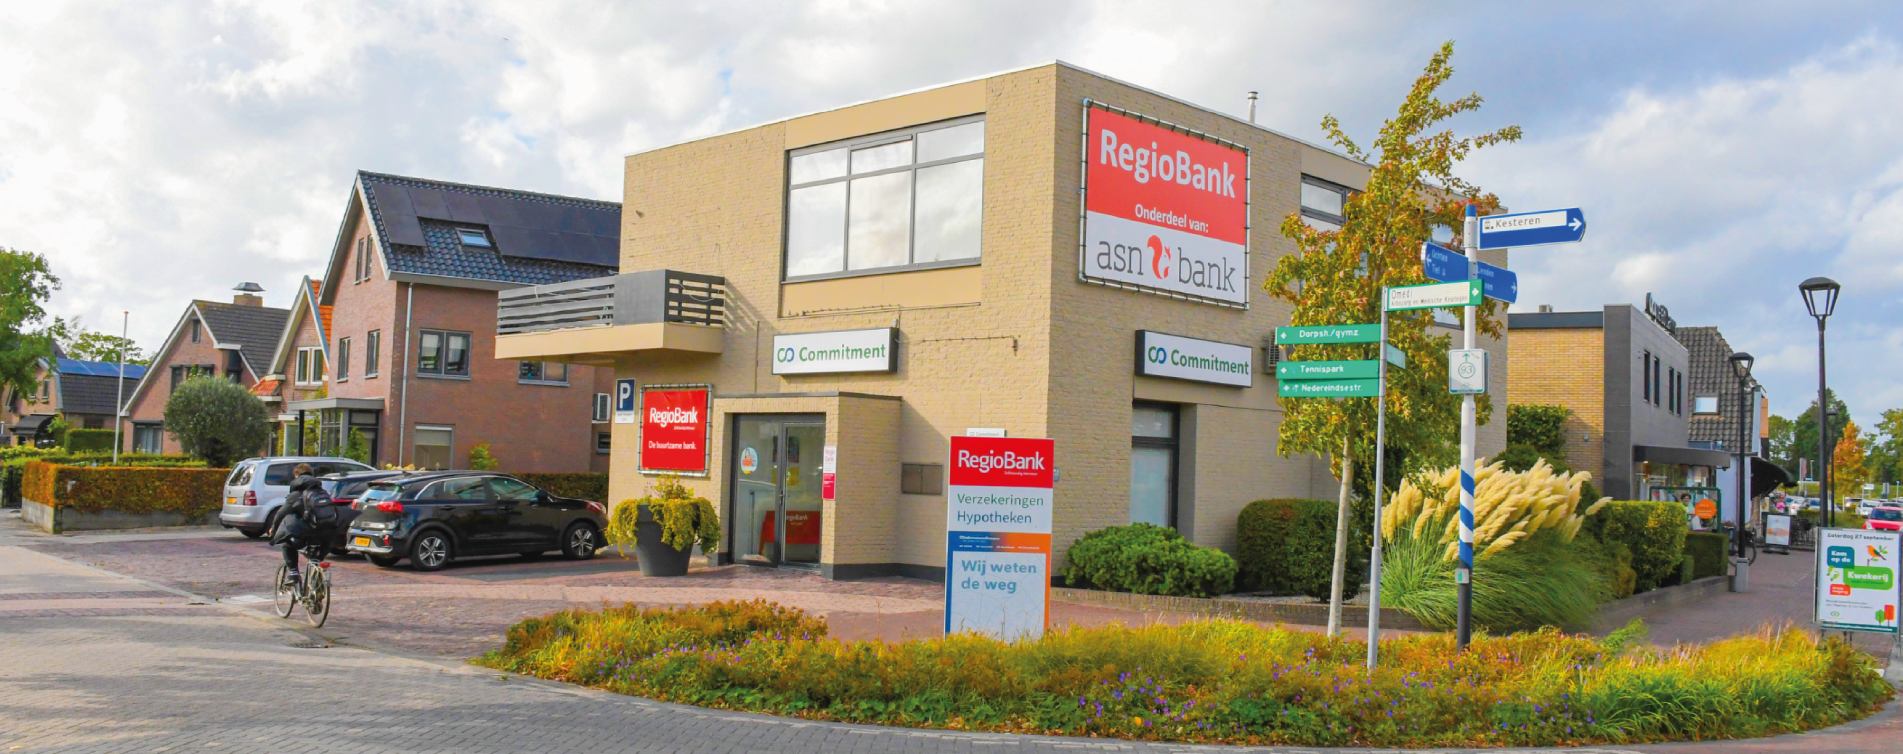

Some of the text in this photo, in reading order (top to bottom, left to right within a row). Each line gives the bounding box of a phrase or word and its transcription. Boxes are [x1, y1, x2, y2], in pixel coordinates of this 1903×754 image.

[1100, 128, 1236, 198] RegioBank
[1135, 203, 1209, 233] Onderdeel van:
[1495, 217, 1541, 228] Kesteren
[1096, 240, 1236, 293] asn bank
[799, 343, 886, 362] Commitment
[1170, 349, 1249, 375] Commitment
[1300, 365, 1344, 373] Tennispark
[619, 382, 631, 409] P
[649, 406, 698, 428] RegioBank
[958, 449, 1045, 473] RegioBank
[957, 493, 1044, 508] Verzekeringen
[957, 510, 1032, 525] Hypotheken
[961, 559, 1037, 576] Wij weten
[961, 577, 1017, 594] de weg
